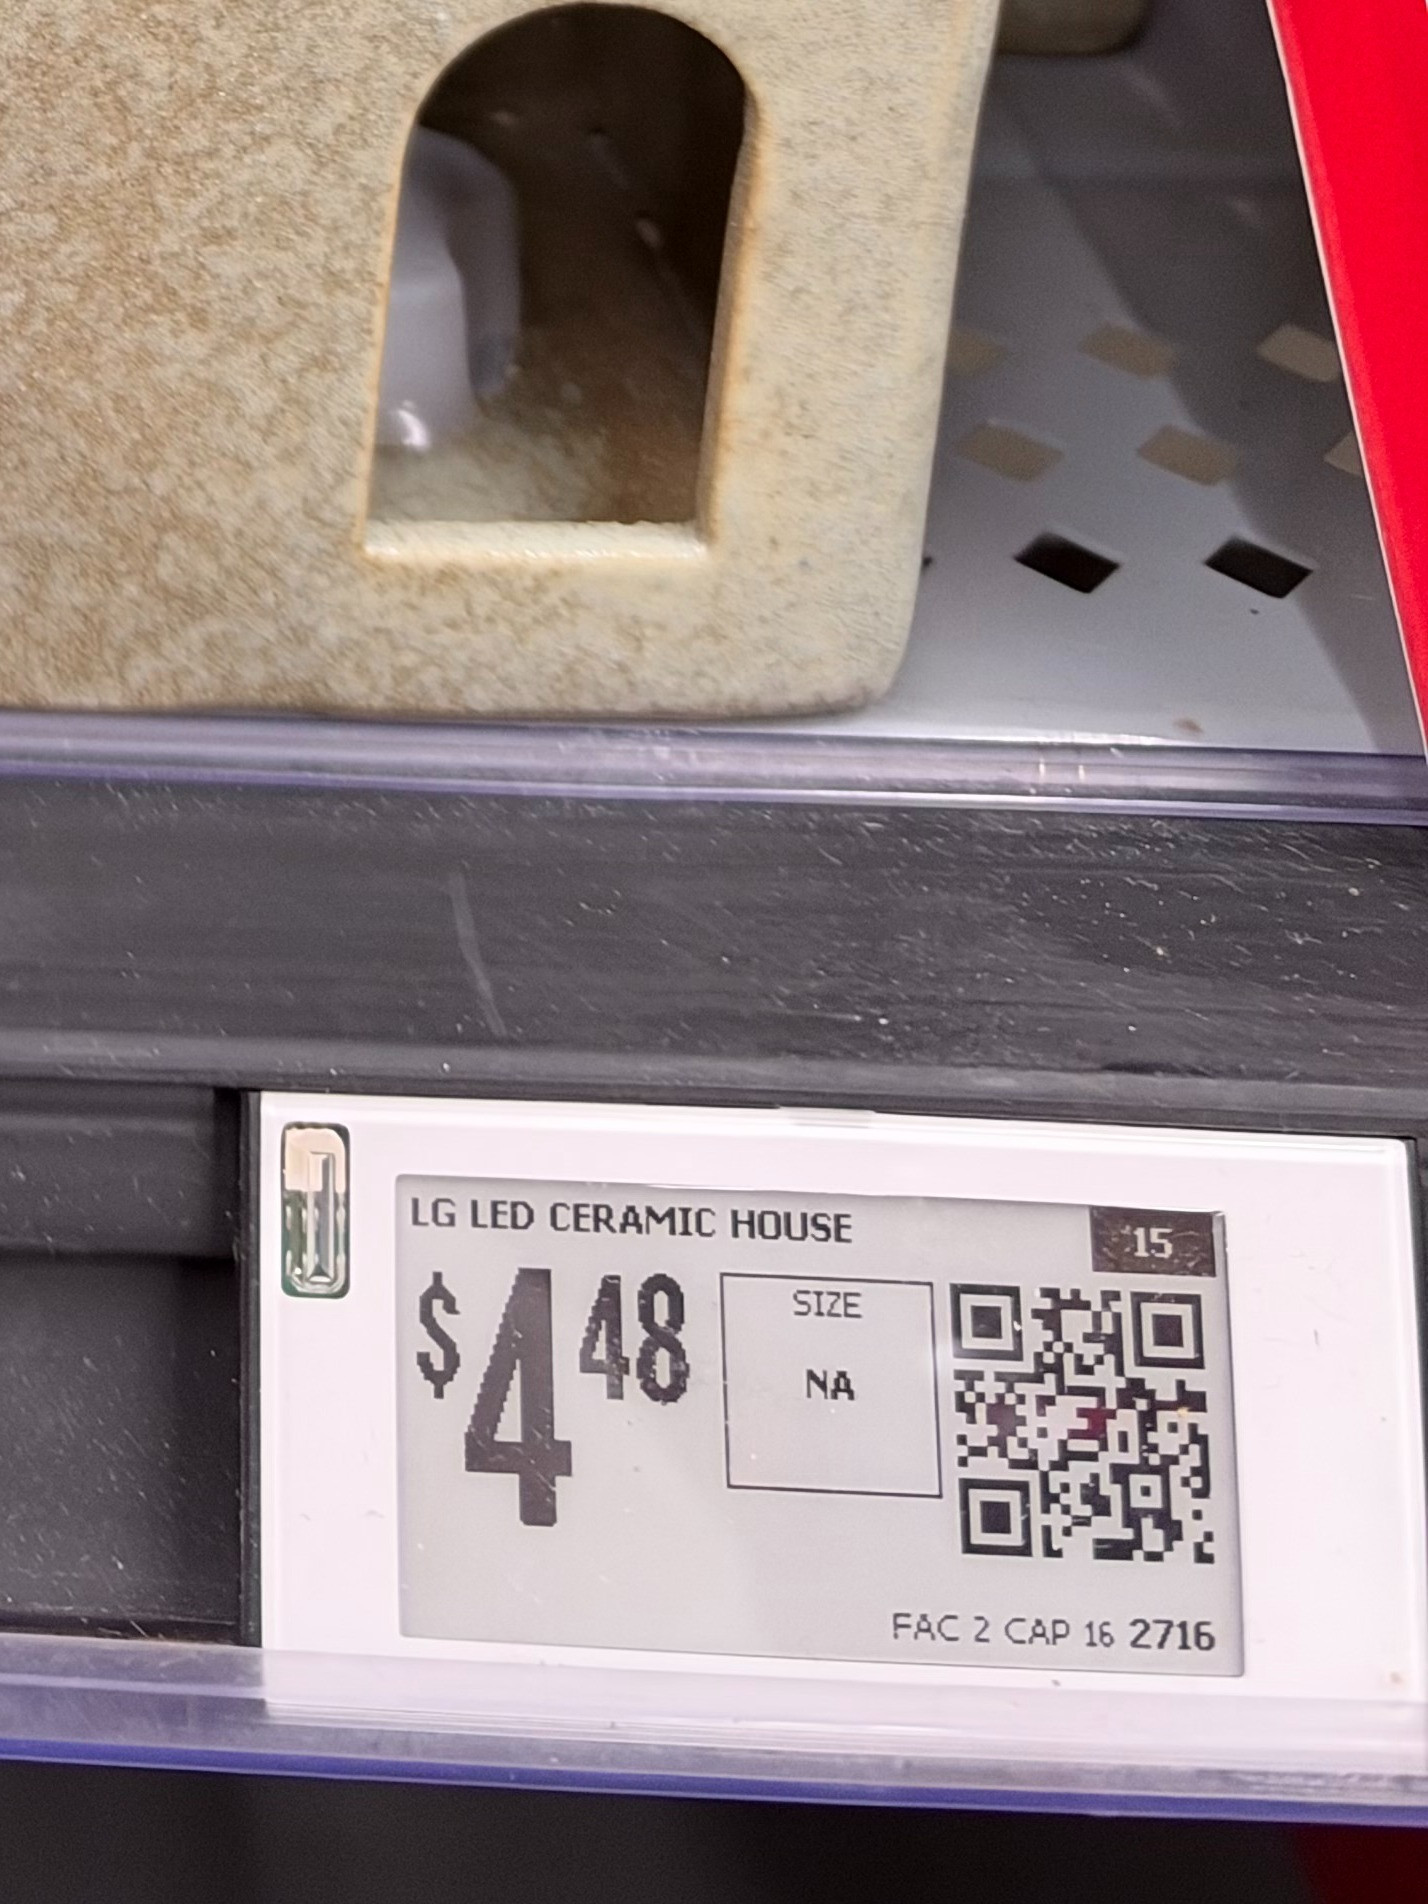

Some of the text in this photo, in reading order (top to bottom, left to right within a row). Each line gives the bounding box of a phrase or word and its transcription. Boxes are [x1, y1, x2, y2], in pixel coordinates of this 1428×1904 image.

[411, 1197, 852, 1244] LG LED CERAMIC HOUSE
[1133, 1227, 1173, 1259] 15
[792, 1289, 862, 1319] SIZE
[806, 1369, 855, 1401] NA
[892, 1612, 1216, 1651] FAC 2 CAP 16 2716
